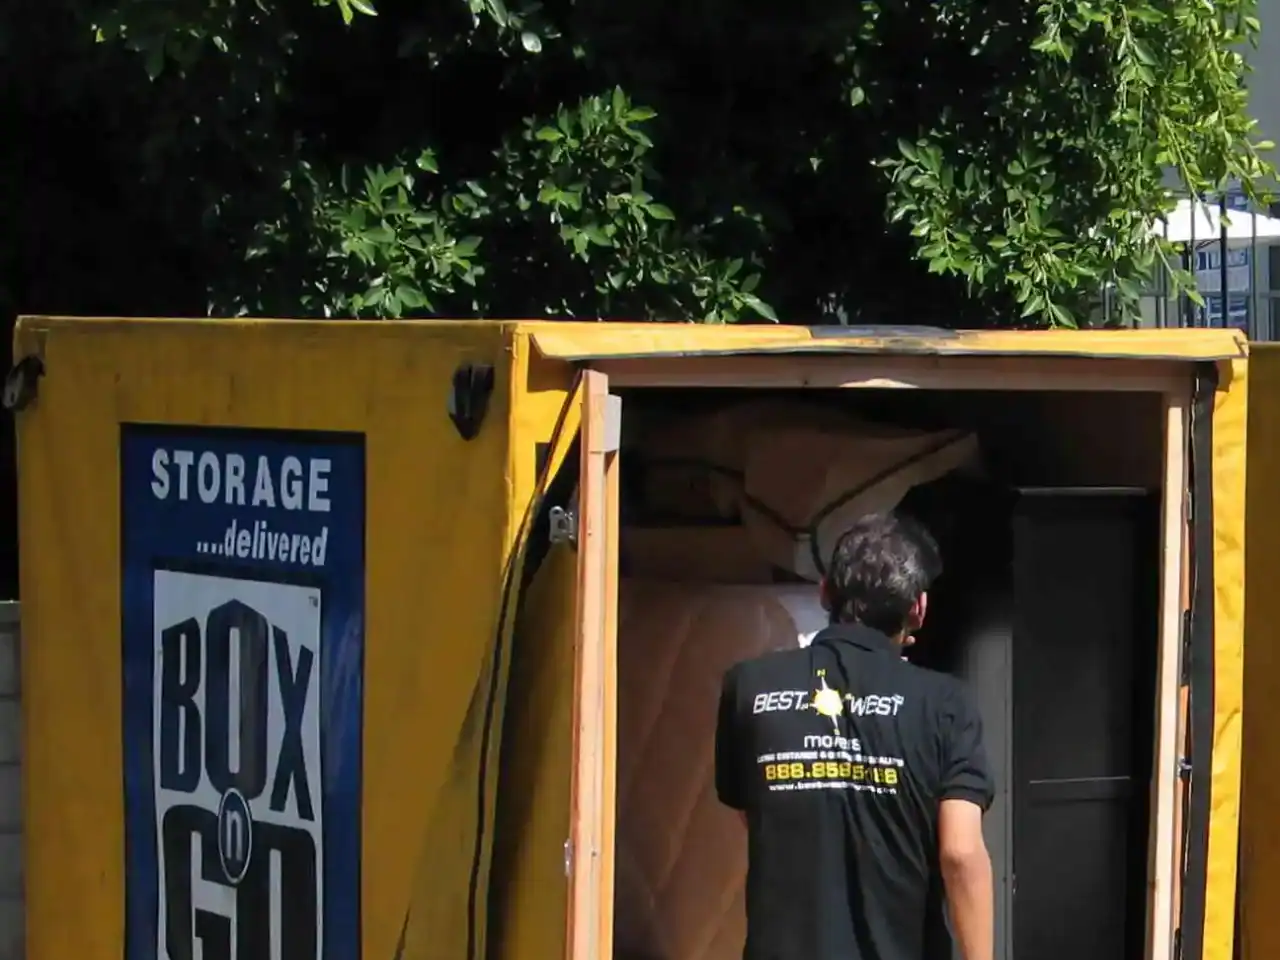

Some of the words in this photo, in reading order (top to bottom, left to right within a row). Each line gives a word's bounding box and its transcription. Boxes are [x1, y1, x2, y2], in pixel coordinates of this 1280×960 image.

[151, 448, 331, 512] STORAGE
[160, 598, 315, 821] BOX
[753, 690, 808, 714] BEST
[850, 694, 902, 717] WEST
[226, 806, 243, 860] n
